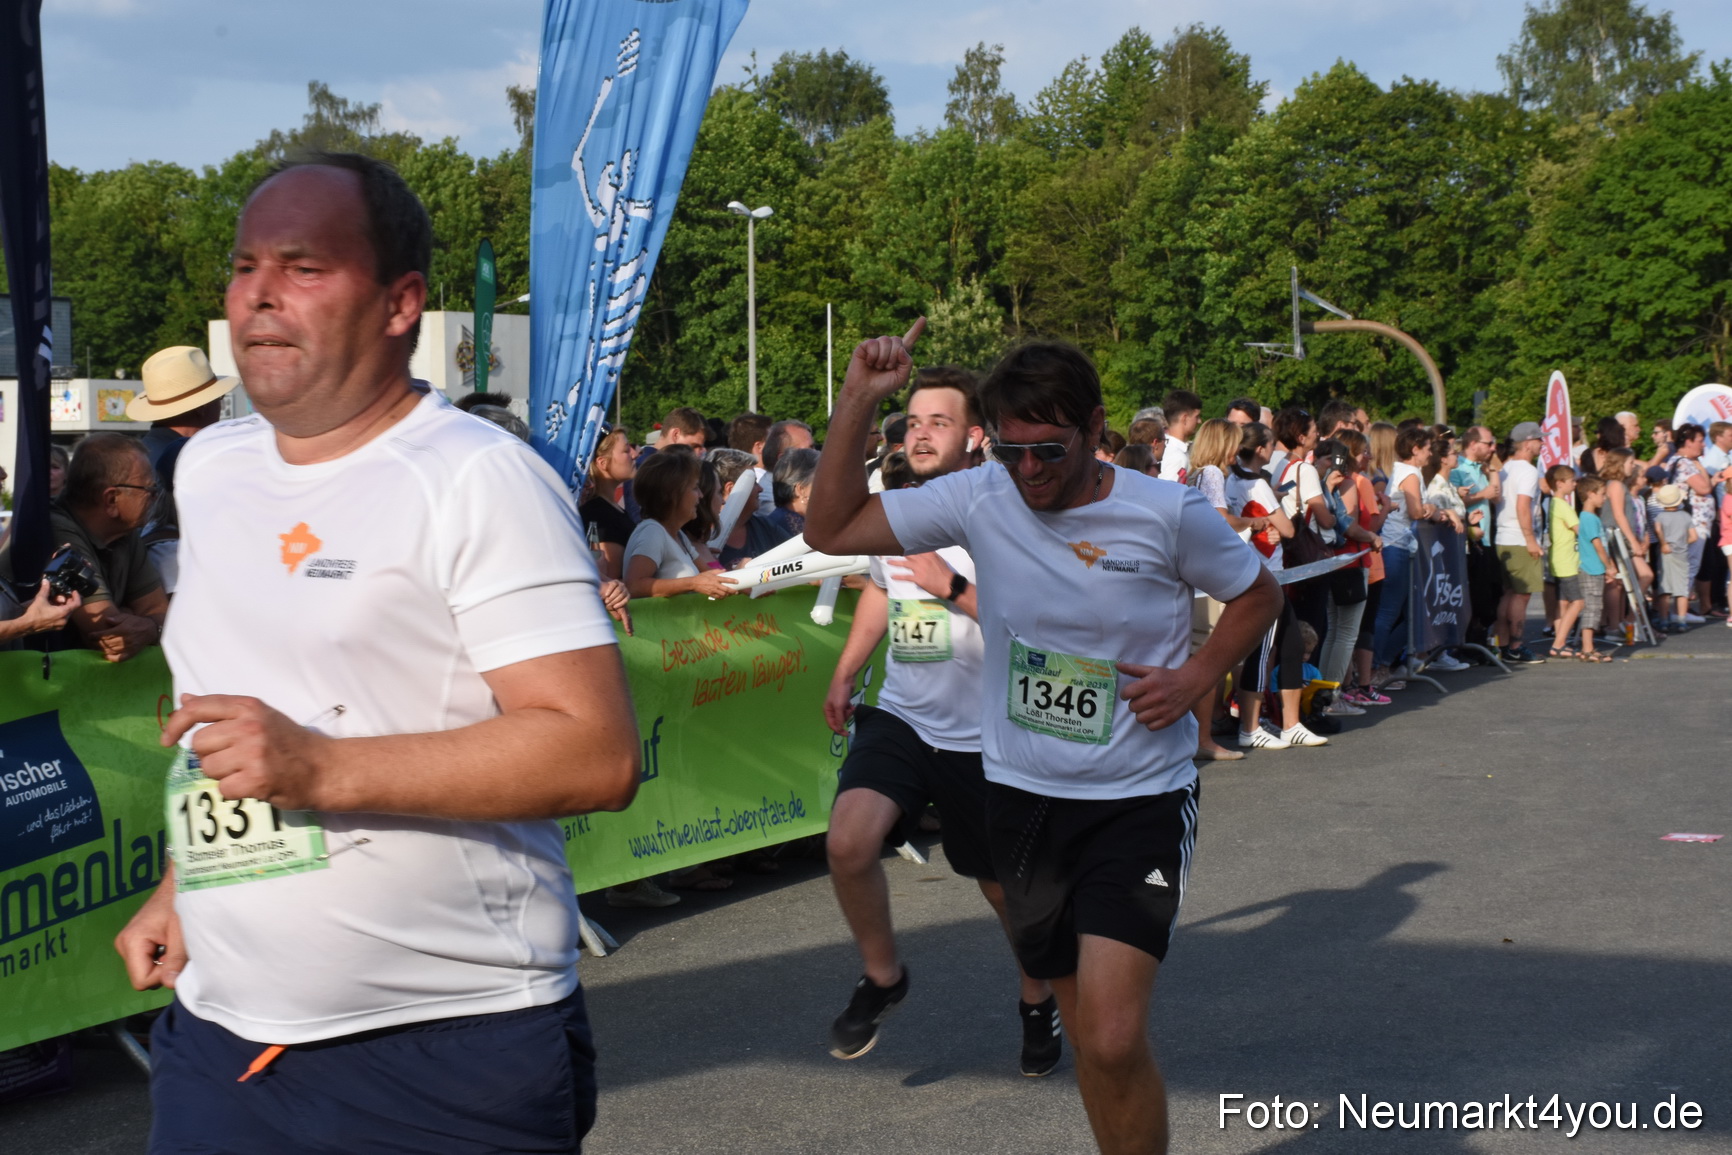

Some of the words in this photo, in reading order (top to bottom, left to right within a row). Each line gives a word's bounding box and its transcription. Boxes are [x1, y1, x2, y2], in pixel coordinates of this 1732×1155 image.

[1102, 558, 1140, 567] LANDKREIS
[1103, 564, 1140, 573] NEUMARKT
[661, 618, 730, 673] Gesunde
[723, 612, 783, 648] Firmen
[892, 621, 937, 643] 2147
[691, 661, 748, 708] laufen
[752, 635, 808, 693] länger!
[1018, 675, 1098, 719] 1346
[1045, 712, 1082, 726] Thorsten
[5, 779, 68, 808] AUTOMOBILE
[45, 808, 60, 822] das
[628, 789, 806, 859] www.firmenlauf-oberpfalz.de
